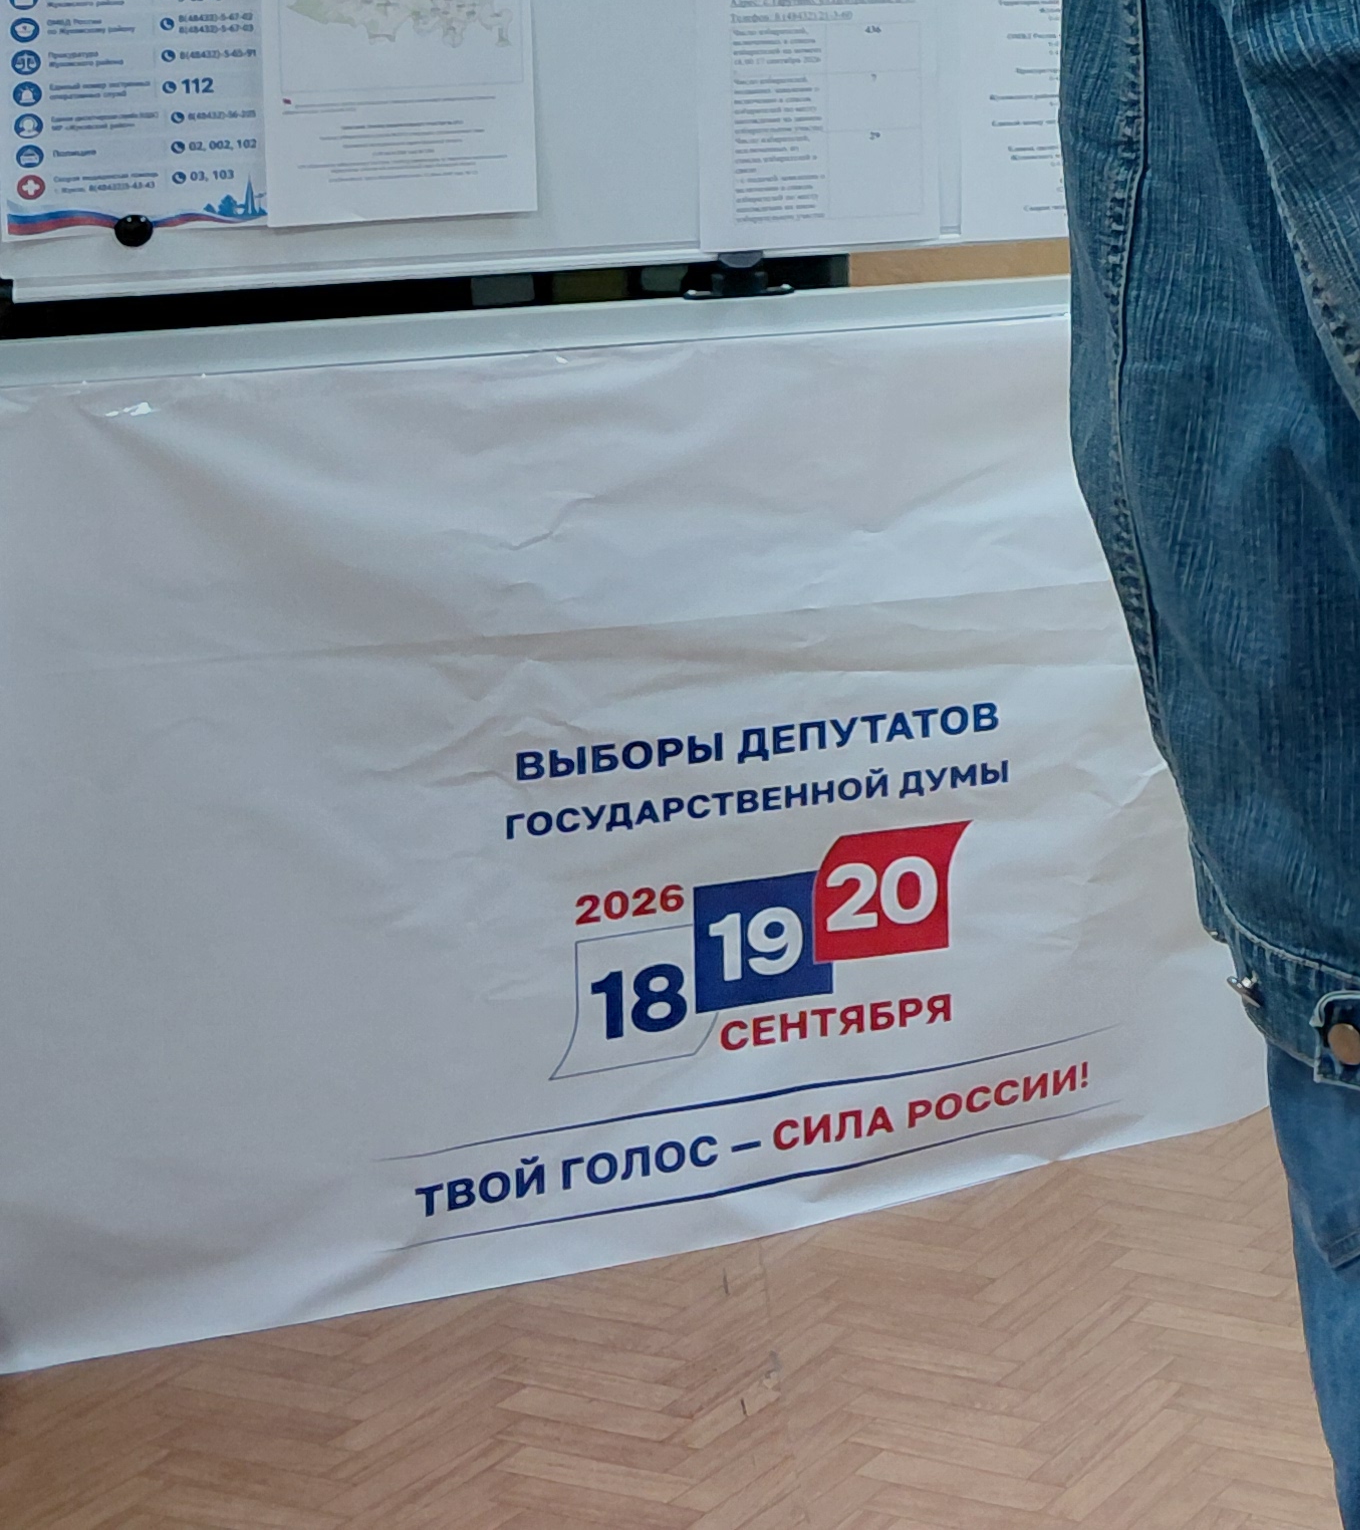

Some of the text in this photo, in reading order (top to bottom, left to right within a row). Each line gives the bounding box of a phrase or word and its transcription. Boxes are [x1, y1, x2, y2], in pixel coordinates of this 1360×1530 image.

[181, 77, 214, 94] 112
[189, 139, 257, 151] 02, 002, 102
[190, 169, 235, 182] 03, 103
[515, 701, 1001, 782] ВЫБОРЫ ДЕПУТАТОВ
[504, 759, 1010, 840] ГОСУДАРСТВЕННОЙ ДУМЫ
[574, 883, 685, 925] 2026
[590, 854, 939, 1041] 18 19 20
[719, 992, 954, 1052] СЕНТЯБРЯ
[414, 1157, 547, 1218] ТВОЙ
[561, 1134, 719, 1191] ГОЛОС
[773, 1098, 895, 1152] СИЛА
[906, 1060, 1091, 1130] РОССИИ!
